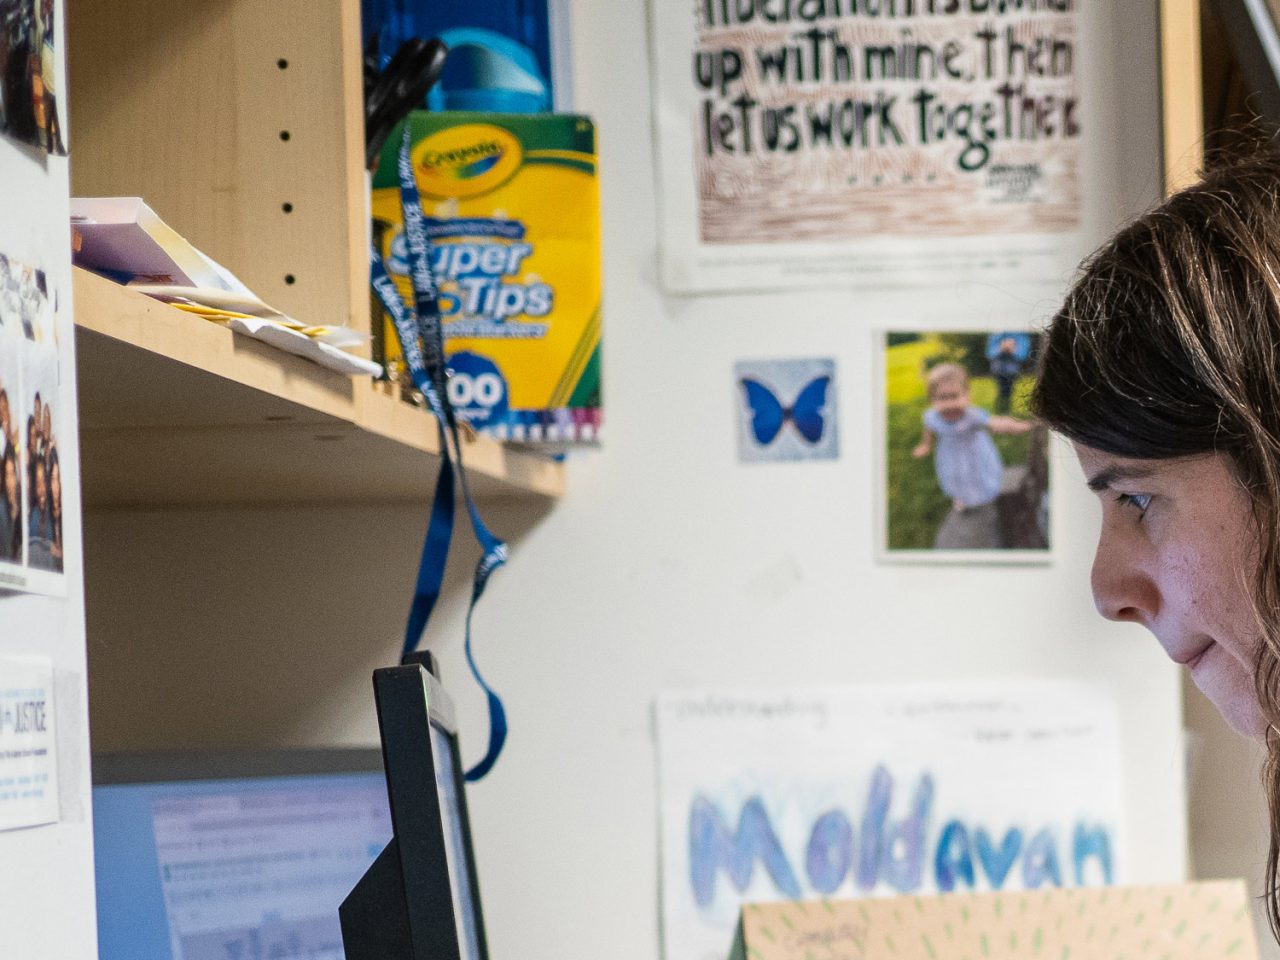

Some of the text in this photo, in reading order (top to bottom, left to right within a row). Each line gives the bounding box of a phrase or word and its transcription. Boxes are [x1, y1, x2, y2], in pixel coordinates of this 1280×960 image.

[695, 49, 741, 97] up
[755, 28, 852, 82] with
[975, 24, 1072, 80] then
[704, 93, 757, 157] let
[763, 105, 800, 152] us
[805, 91, 903, 150] work
[387, 235, 533, 281] Super
[460, 275, 553, 318] Tips
[446, 372, 502, 408] 00
